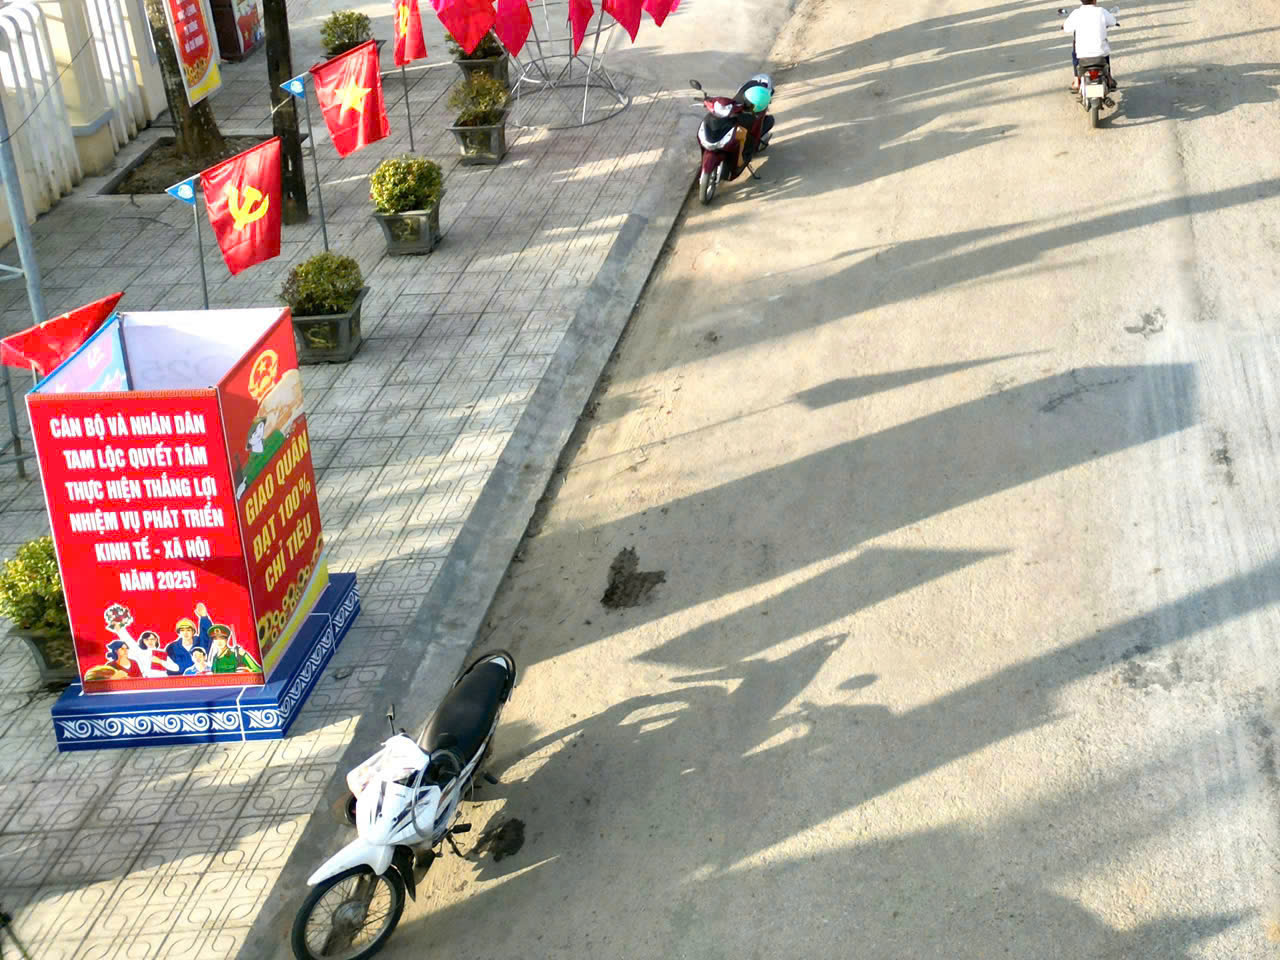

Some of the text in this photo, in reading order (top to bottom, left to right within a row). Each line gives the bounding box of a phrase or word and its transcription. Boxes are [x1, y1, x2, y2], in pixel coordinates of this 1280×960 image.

[49, 411, 206, 440] CÁN BỘ VÀ NHÂN DÂN
[63, 441, 208, 472] TAM LỘC QUYẾT TÂM
[65, 472, 217, 504] THỰC HIỆN THẮNG LỢI
[245, 429, 308, 526] GIAO QUÂN
[69, 501, 224, 534] NHIỆM VỤ PHÁT TRIỂN
[253, 472, 311, 563] ĐẠT 100%
[95, 541, 131, 562] KINH
[133, 536, 151, 560] TẾ
[163, 537, 183, 559] XÃ
[185, 536, 211, 561] HỘI
[265, 512, 312, 592] CHỈ TIÊU
[120, 569, 197, 591] NĂM 2025!
